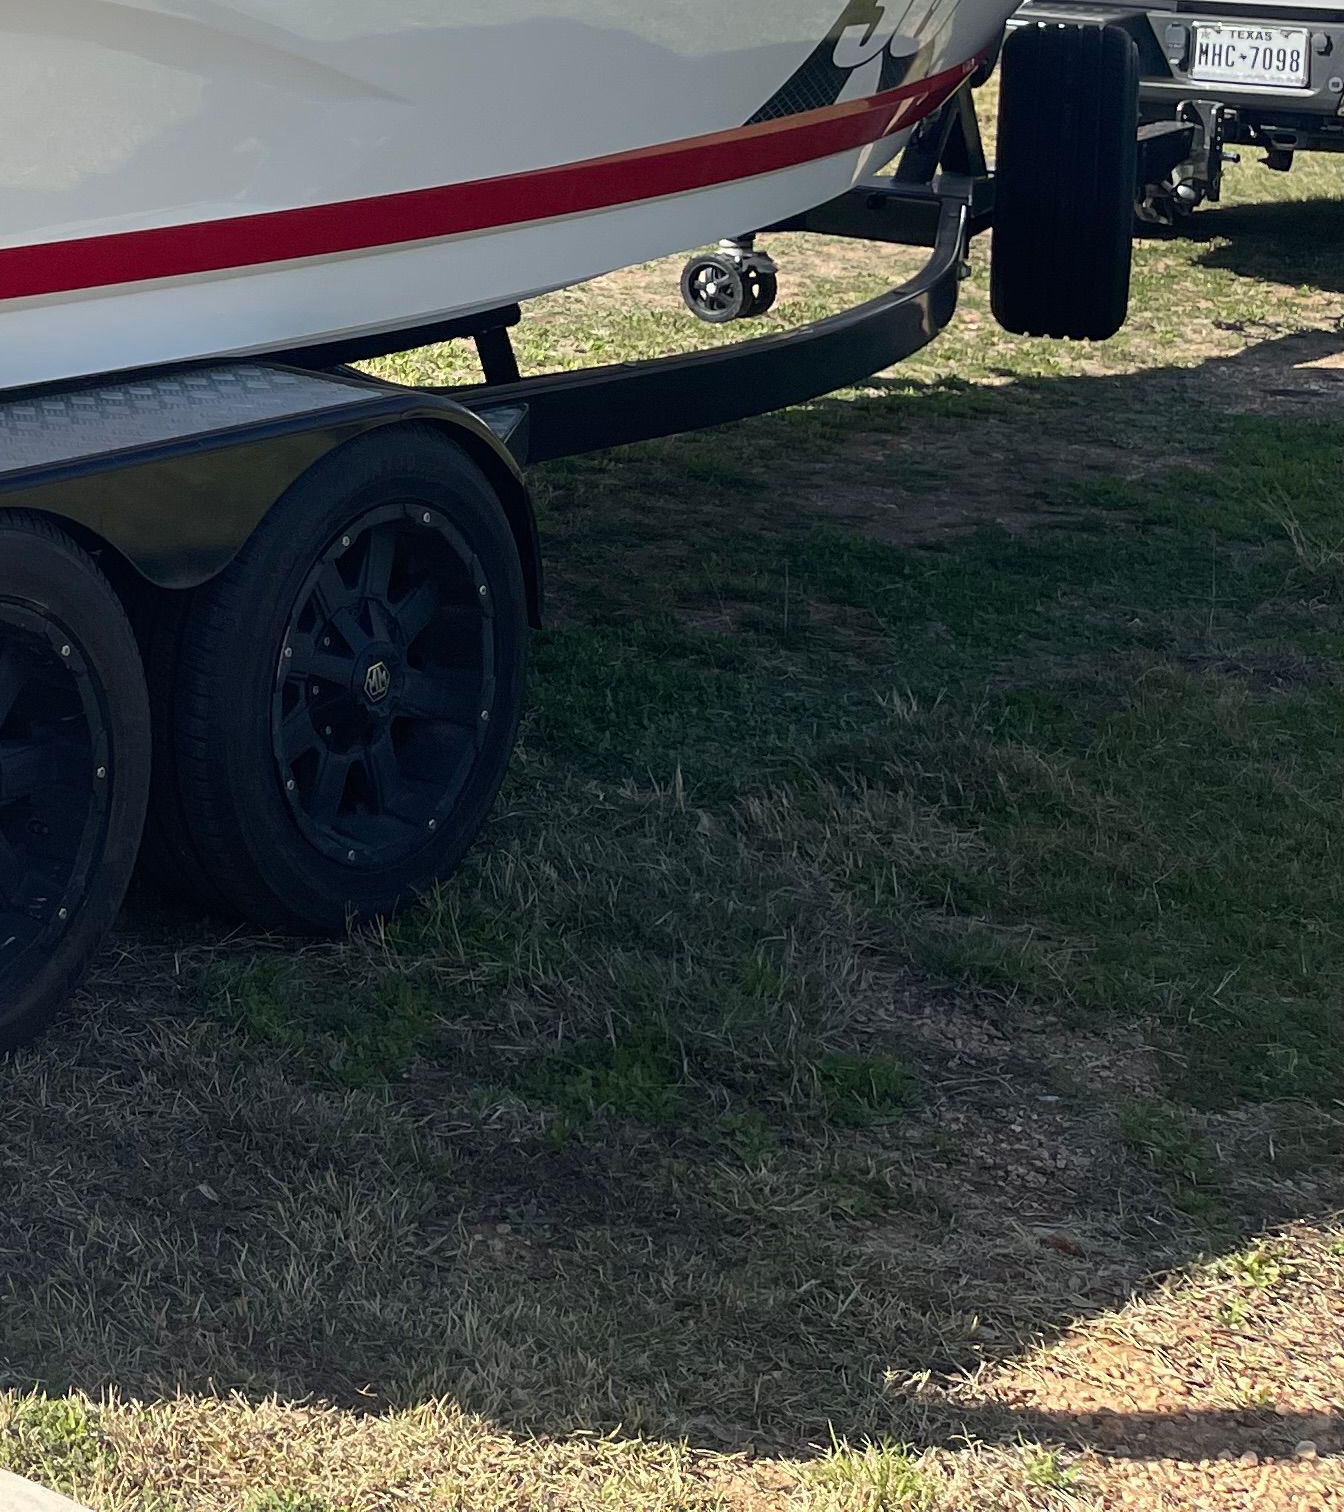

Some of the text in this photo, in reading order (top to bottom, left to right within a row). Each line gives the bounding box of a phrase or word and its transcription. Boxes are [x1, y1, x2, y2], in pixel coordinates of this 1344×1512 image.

[1230, 29, 1273, 41] TEXAS
[1198, 43, 1300, 72] MHC 7098
